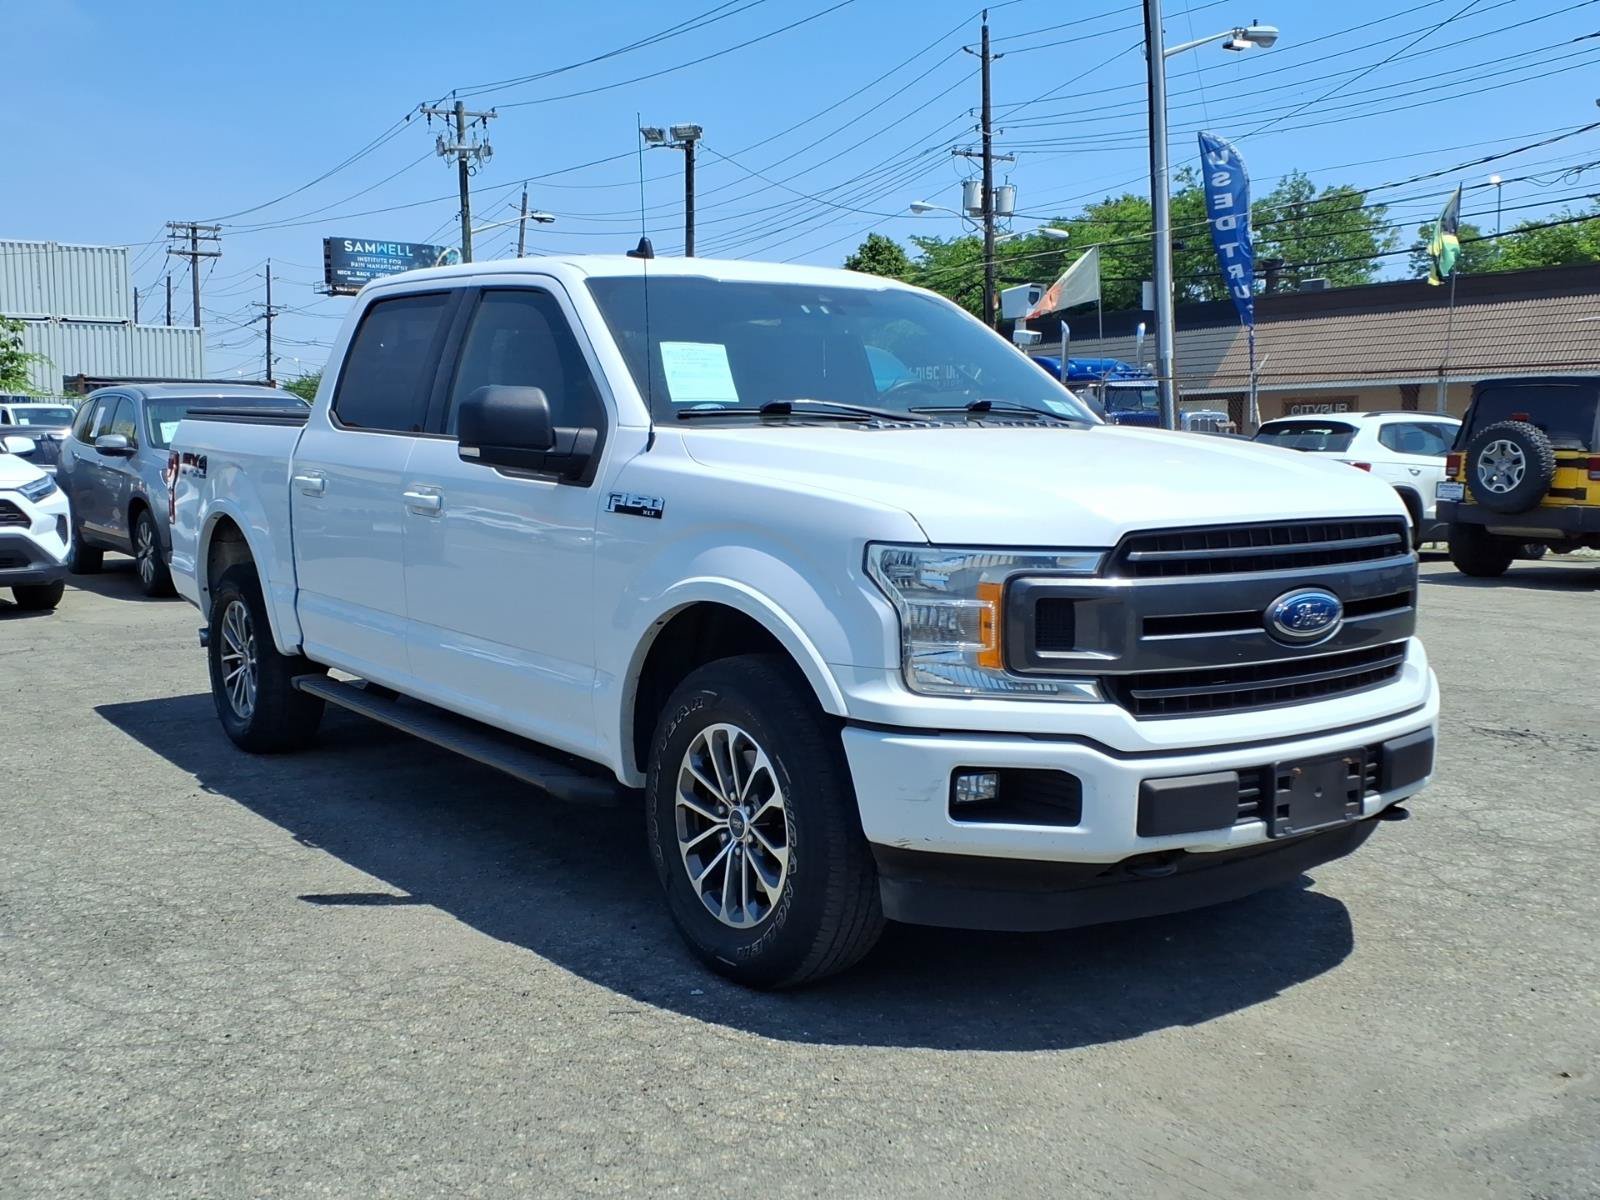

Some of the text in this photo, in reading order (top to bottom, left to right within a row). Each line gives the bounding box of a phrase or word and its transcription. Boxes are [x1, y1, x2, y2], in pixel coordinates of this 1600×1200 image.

[344, 240, 413, 256] SAMWELL
[357, 256, 402, 266] INSTITUTE FOR
[1292, 602, 1329, 628] Ford
